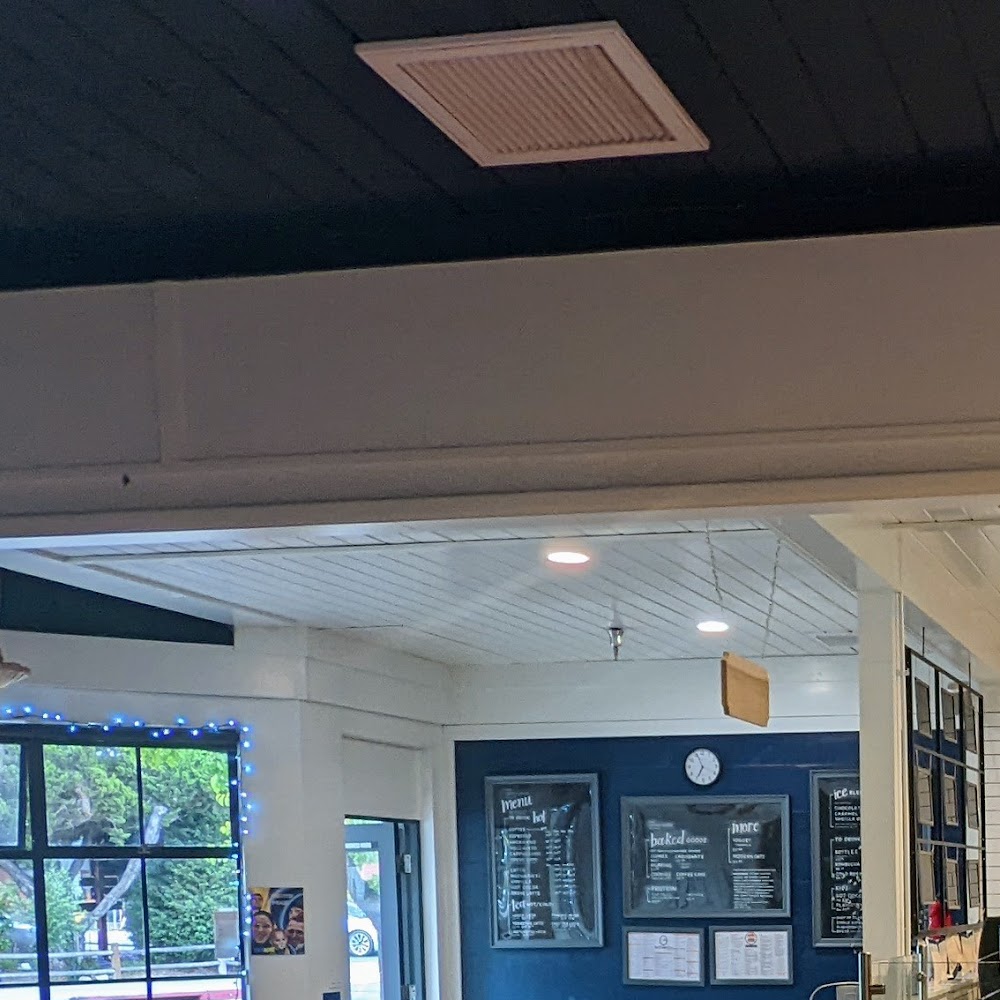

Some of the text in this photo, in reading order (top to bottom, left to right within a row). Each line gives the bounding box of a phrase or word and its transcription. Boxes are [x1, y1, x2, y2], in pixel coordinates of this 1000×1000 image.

[501, 795, 533, 814] menu
[731, 822, 760, 834] more
[650, 829, 685, 848] baked
